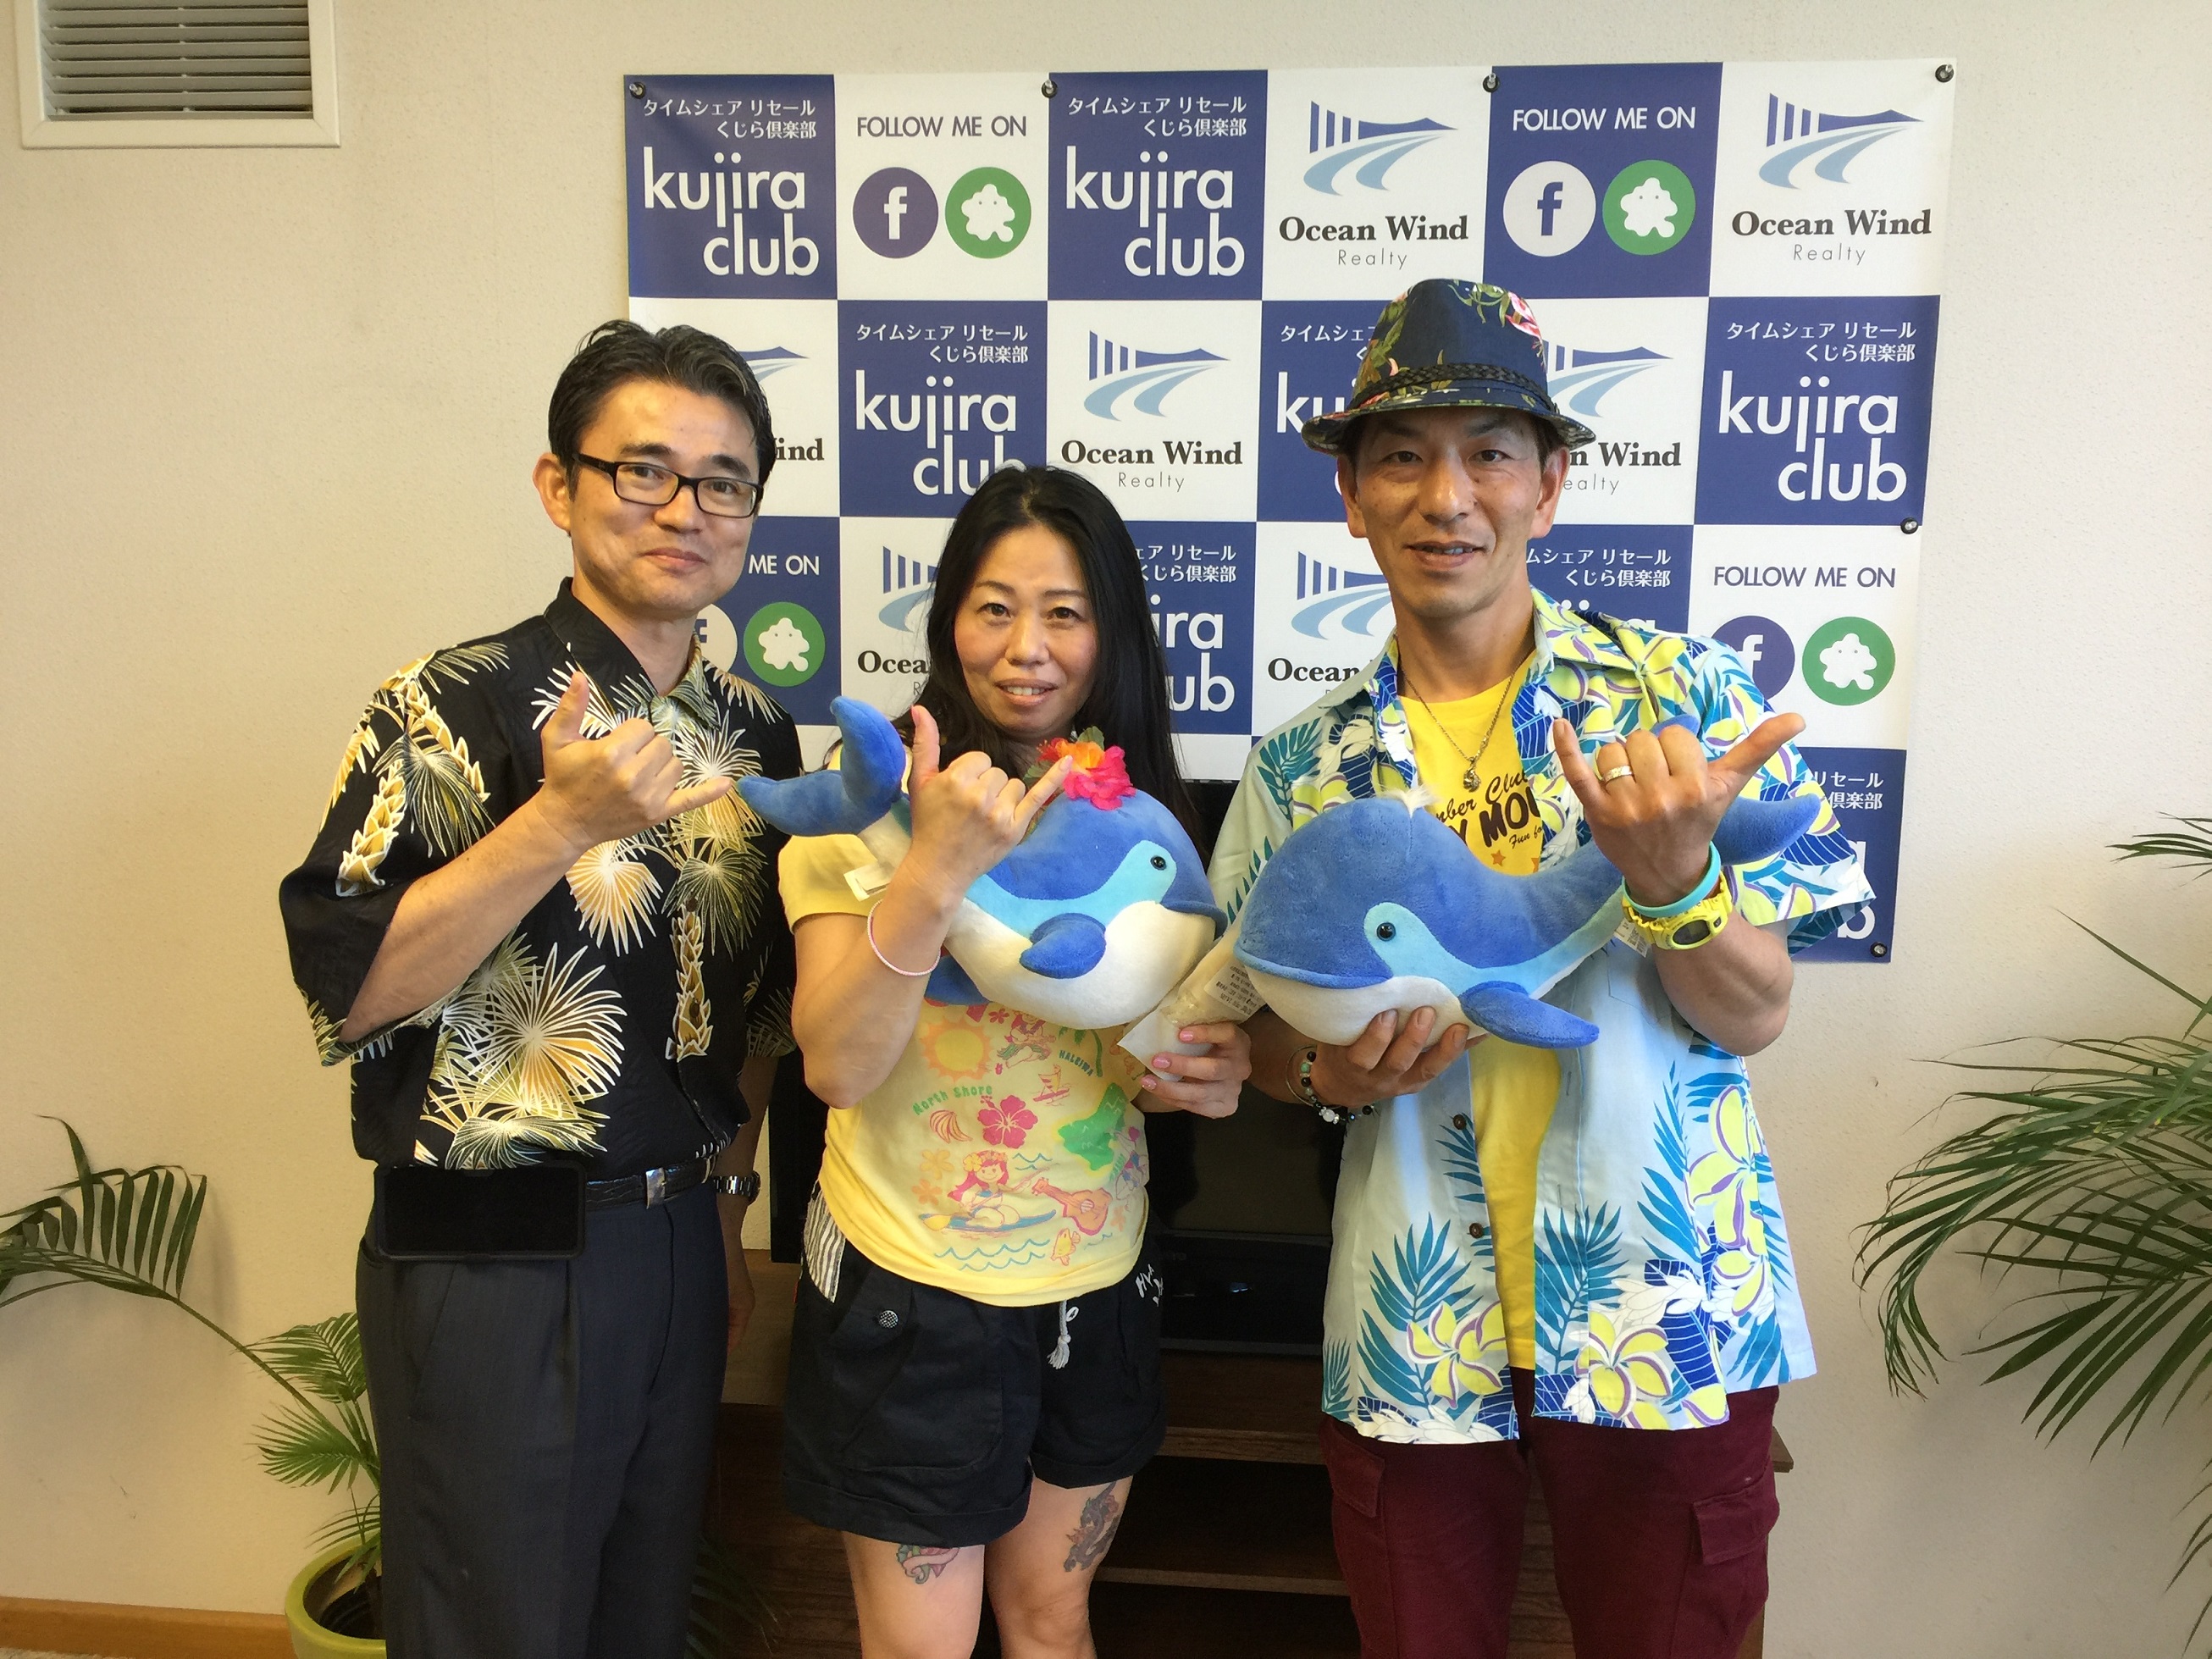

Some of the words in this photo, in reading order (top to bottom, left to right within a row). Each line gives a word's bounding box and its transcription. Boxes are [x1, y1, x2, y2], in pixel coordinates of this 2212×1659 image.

[643, 99, 743, 117] タイムシェア
[750, 99, 816, 116] リセール
[1068, 97, 1170, 115] タイムシェア
[1179, 96, 1247, 113] リセール
[716, 121, 816, 139] くじら倶楽部
[857, 116, 943, 137] FOLLOW
[952, 116, 982, 136] ME
[991, 115, 1027, 136] ON
[1144, 118, 1247, 137] くじら倶楽部
[1512, 108, 1606, 131] FOLLOW
[1614, 108, 1647, 130] ME
[1656, 107, 1696, 129] ON
[644, 147, 805, 227] kujira
[1066, 146, 1233, 228] kujira
[1279, 216, 1375, 242] Ocean
[1385, 215, 1468, 241] Wind
[1732, 210, 1834, 236] Ocean
[1844, 208, 1932, 235] Wind
[703, 213, 820, 276] club
[1124, 213, 1245, 276] club
[1794, 243, 1866, 266] Realty
[1337, 248, 1407, 268] Realty
[856, 324, 954, 342] タイムシェア
[962, 324, 1028, 342] リセール
[1727, 322, 1834, 340] タイムシェア
[1844, 321, 1916, 340] リセール
[929, 345, 1029, 364] くじら倶楽部
[1806, 343, 1916, 362] くじら倶楽部
[855, 369, 1017, 449] kujira
[1718, 370, 1900, 452] kujira
[774, 437, 824, 462] ind
[1061, 440, 1155, 465] Ocean
[1163, 440, 1243, 465] Wind
[1598, 442, 1682, 467] Wind
[1778, 437, 1907, 502] club
[1118, 472, 1186, 492] Realty
[1563, 473, 1619, 495] ealty
[1171, 545, 1236, 561] リセール
[1525, 548, 1594, 565] ムシェア
[1602, 549, 1671, 566] リセール
[749, 555, 777, 575] ME
[786, 555, 820, 576] ON
[1565, 569, 1671, 588] くじら倶楽部
[1713, 567, 1806, 587] FOLLOW
[1814, 567, 1847, 588] ME
[1856, 567, 1896, 588] ON
[1149, 594, 1225, 650] ira
[857, 650, 929, 674] Ocea
[1165, 652, 1236, 712] ub
[1814, 771, 1884, 788] リセール
[1828, 791, 1883, 810] 倶楽部
[953, 1085, 993, 1098] Shore
